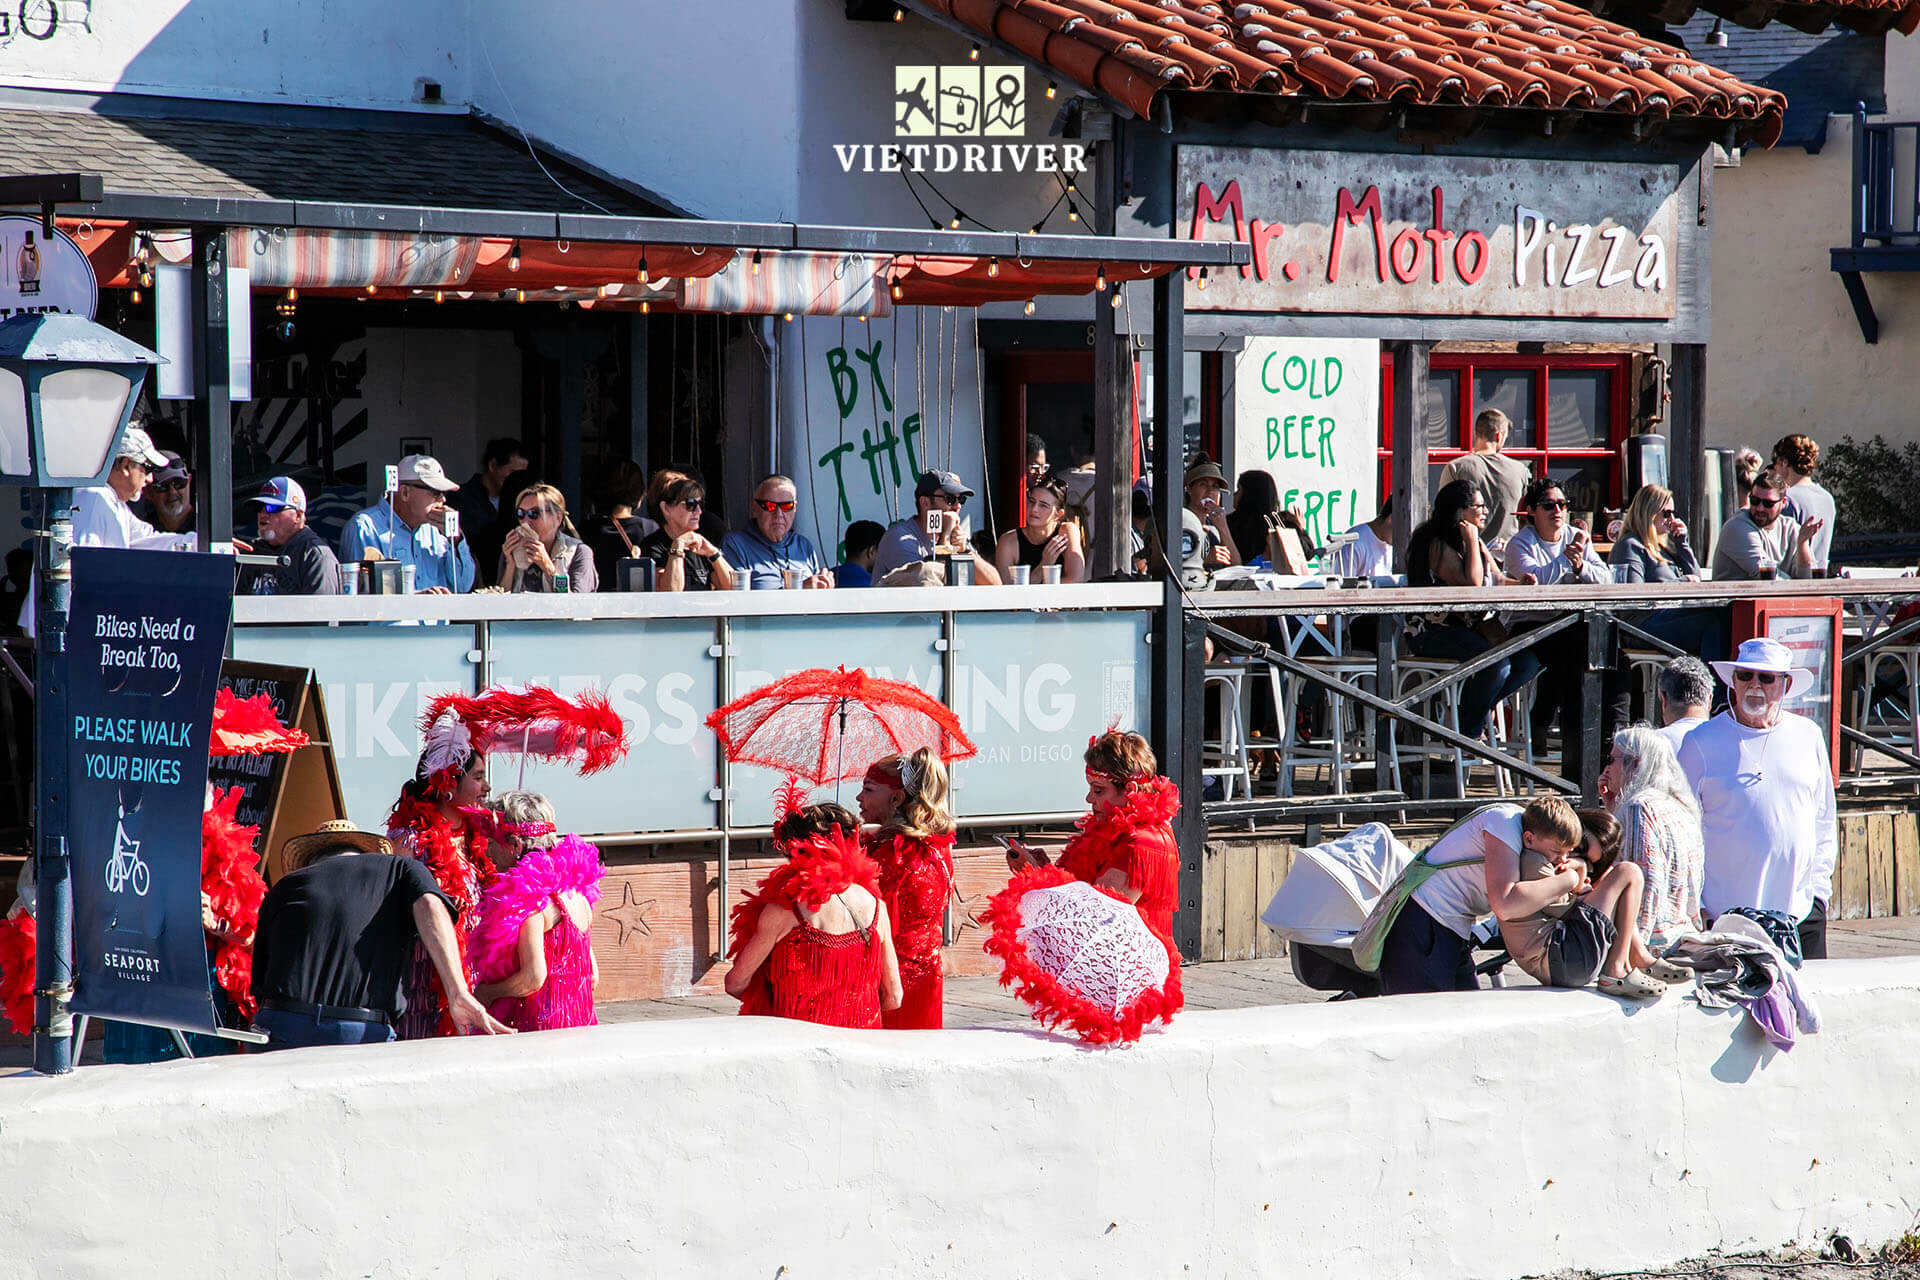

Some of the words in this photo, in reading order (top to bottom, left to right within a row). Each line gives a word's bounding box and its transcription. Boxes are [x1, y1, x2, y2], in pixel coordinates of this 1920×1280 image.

[1187, 180, 1300, 282] Mr.
[1328, 184, 1489, 285] Moto
[1514, 204, 1667, 291] Pizza
[826, 340, 892, 419] BY
[1261, 351, 1342, 399] COLD
[1266, 415, 1335, 467] BEER
[930, 514, 940, 529] 80
[95, 615, 136, 638] Bikes
[139, 617, 181, 640] Need
[184, 624, 195, 641] a
[100, 644, 146, 667] Break
[150, 646, 181, 672] Too,
[75, 716, 136, 743] PLEASE
[141, 720, 192, 747] WALK
[978, 746, 1010, 764] SAN
[1020, 744, 1072, 762] DIEGO
[85, 754, 128, 780] YOUR
[131, 757, 181, 784] BIKES
[104, 952, 160, 973] SEAPORT
[118, 971, 151, 982] VILLAGE
